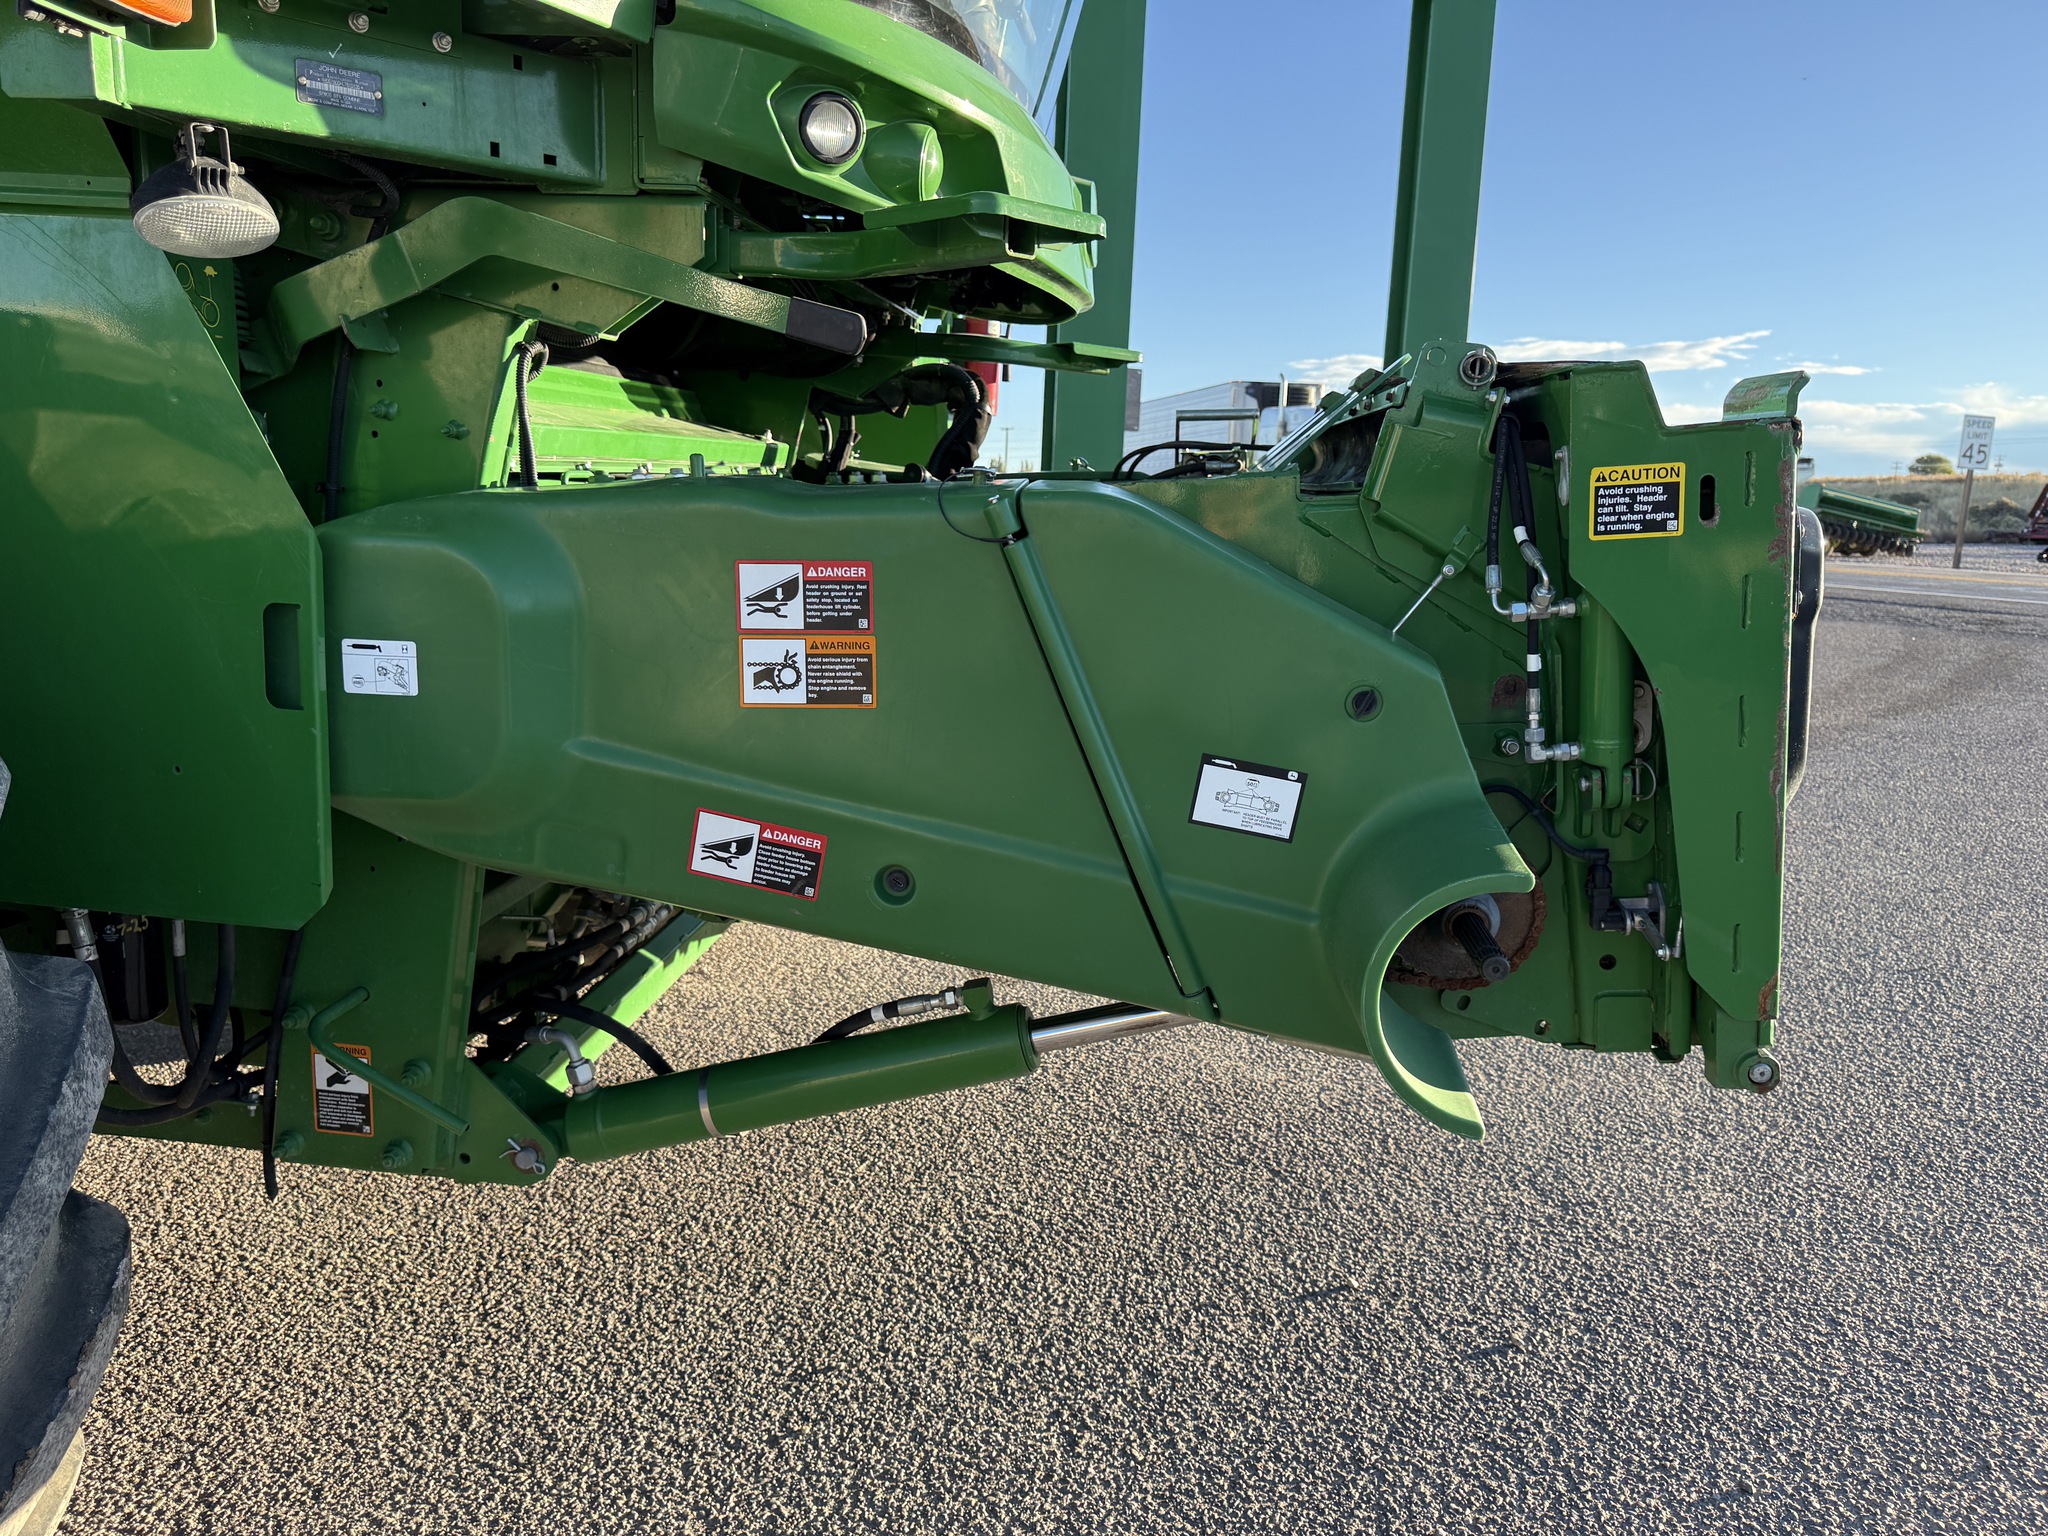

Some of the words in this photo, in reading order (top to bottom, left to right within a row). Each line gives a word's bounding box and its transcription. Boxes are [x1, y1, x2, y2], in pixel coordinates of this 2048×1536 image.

[319, 65, 336, 73] JOHN
[339, 69, 360, 78] DEERE
[1966, 420, 1992, 429] SPEED
[1968, 432, 1988, 440] LIMIT
[1962, 443, 1988, 464] 45
[1609, 466, 1680, 482] CAUTION
[1637, 494, 1667, 502] Header
[1634, 504, 1653, 512] Stay
[1645, 512, 1674, 520] engine
[1607, 522, 1642, 531] running.
[818, 567, 866, 577] DANGER
[820, 642, 870, 650] WARNING
[774, 831, 821, 849] DANGER
[772, 847, 791, 855] crushing
[754, 872, 781, 883] components
[791, 869, 808, 877] damage
